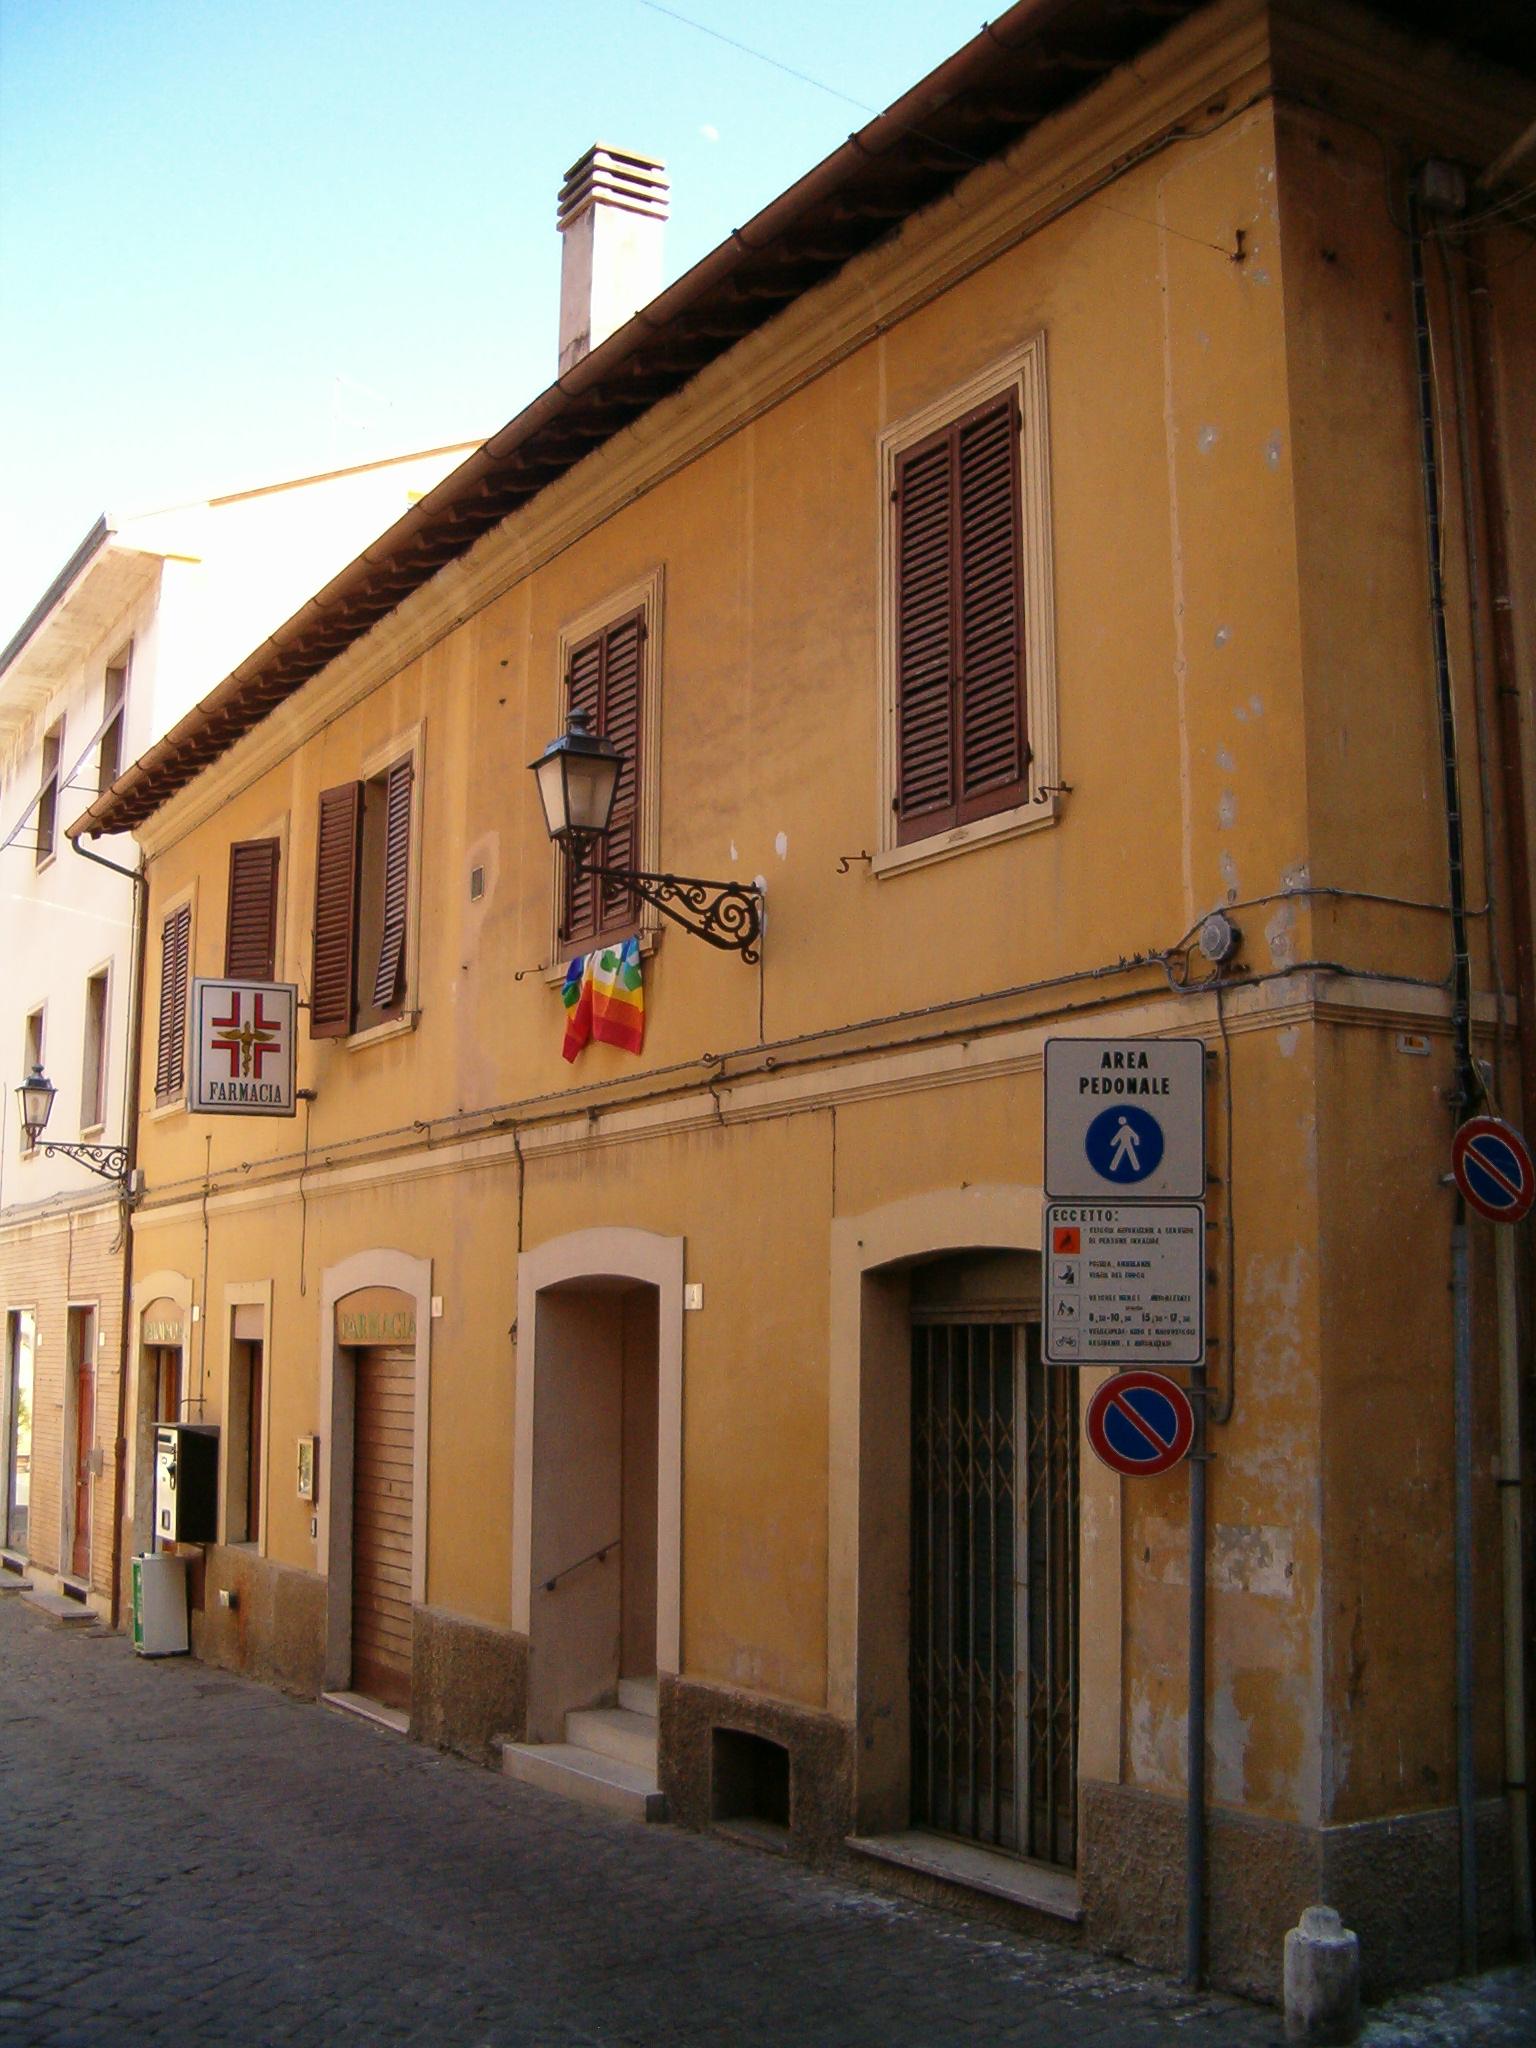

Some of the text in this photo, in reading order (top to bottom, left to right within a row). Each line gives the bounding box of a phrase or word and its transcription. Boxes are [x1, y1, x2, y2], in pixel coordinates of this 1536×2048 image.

[1101, 1051, 1148, 1069] AREA
[209, 1081, 282, 1103] FARMACIA
[1079, 1077, 1170, 1095] PEDONALE
[1053, 1210, 1119, 1222] ECCETTO:
